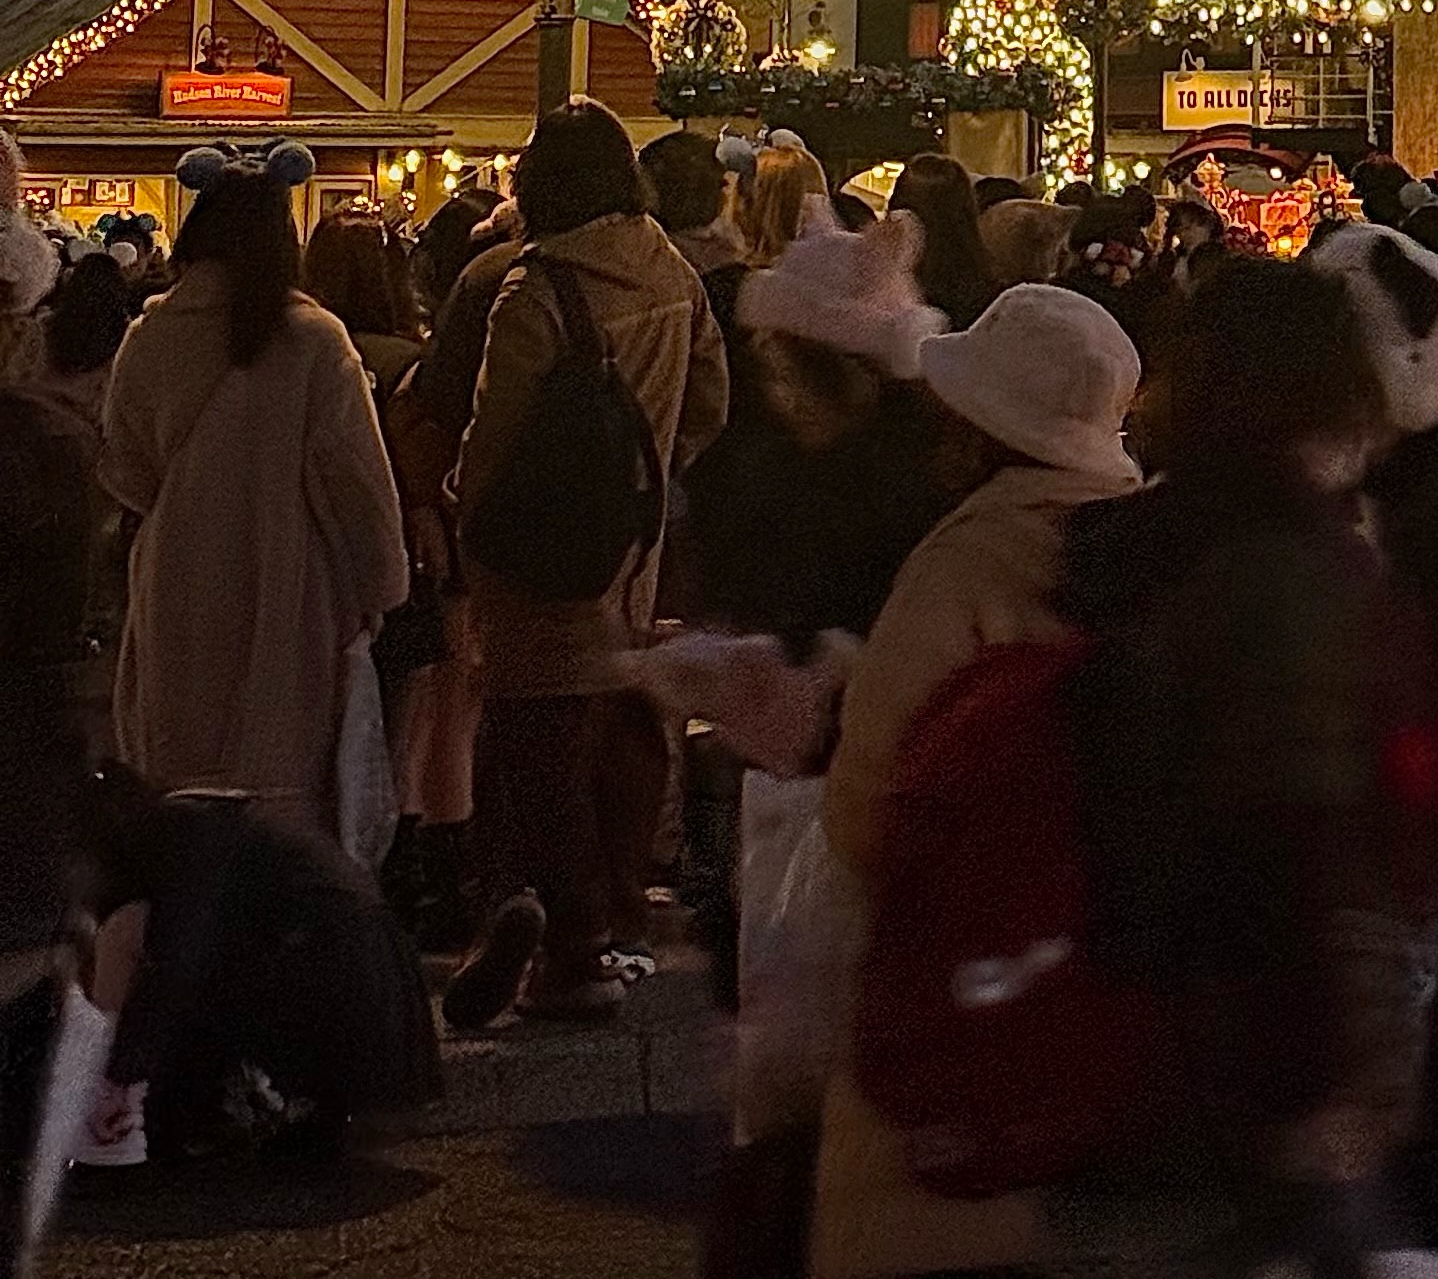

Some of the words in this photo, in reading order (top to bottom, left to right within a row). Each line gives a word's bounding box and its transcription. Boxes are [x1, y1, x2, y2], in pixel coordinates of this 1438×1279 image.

[213, 84, 242, 99] River
[1177, 89, 1198, 110] TO
[1203, 89, 1234, 109] ALL
